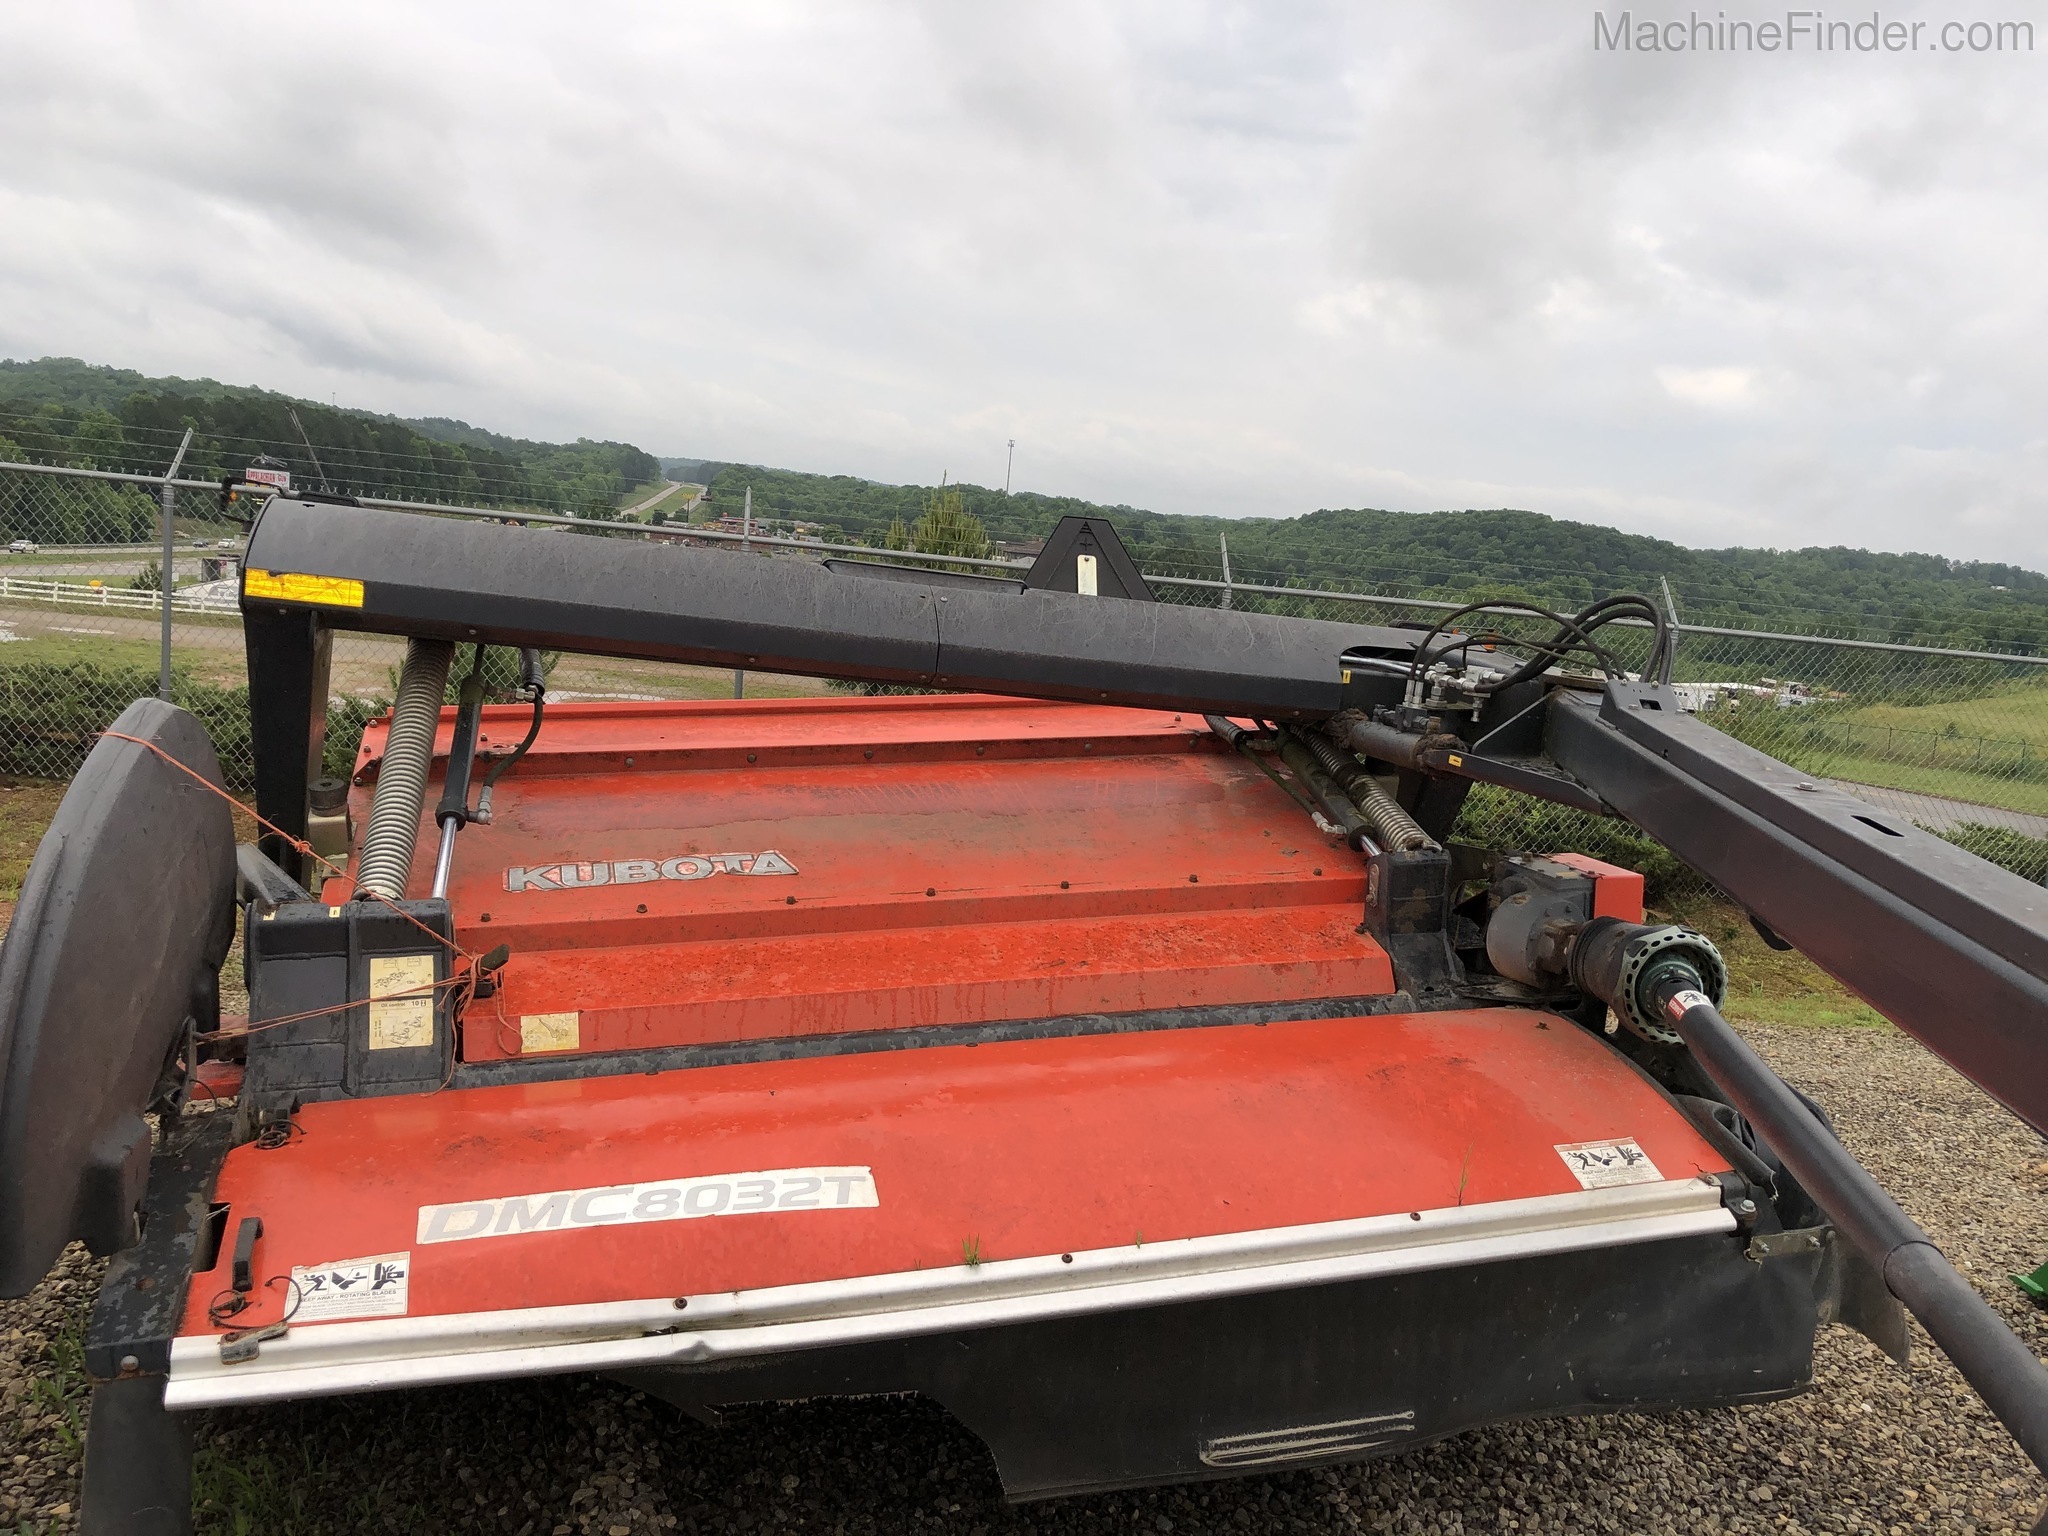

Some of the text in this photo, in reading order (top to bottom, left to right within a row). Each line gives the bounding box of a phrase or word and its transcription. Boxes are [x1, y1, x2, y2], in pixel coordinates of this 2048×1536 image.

[508, 850, 799, 892] KUBOTA
[423, 1175, 867, 1242] DMC8032T
[340, 1291, 371, 1299] ROTATING
[372, 1289, 397, 1297] BLADES
